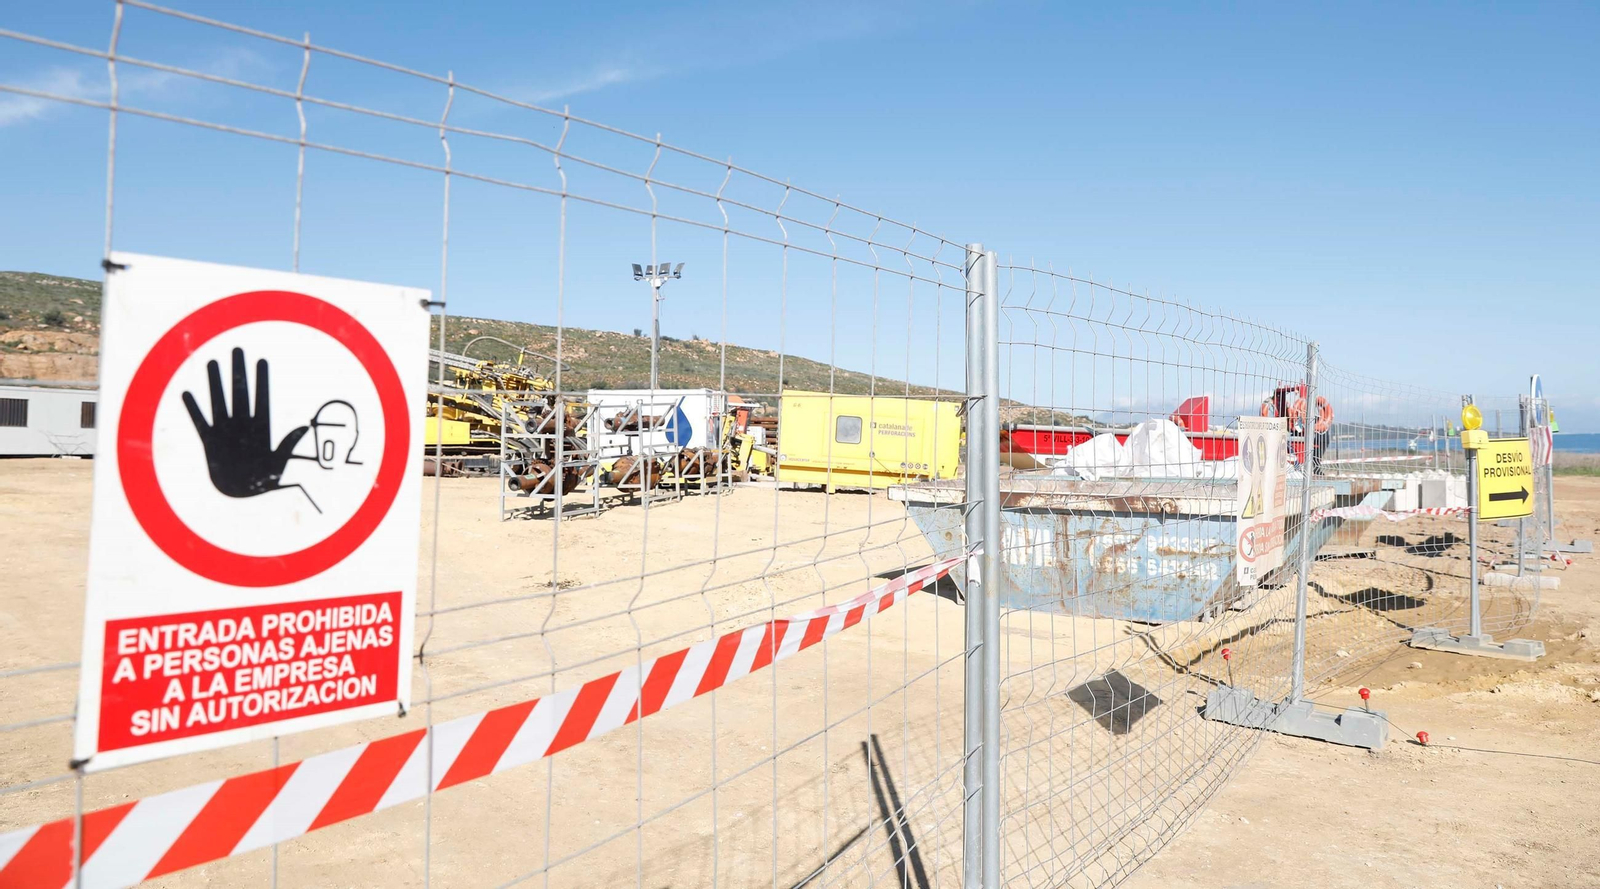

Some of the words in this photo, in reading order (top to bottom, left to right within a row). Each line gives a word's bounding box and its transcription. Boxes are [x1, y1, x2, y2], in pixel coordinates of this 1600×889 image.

[1483, 465, 1532, 478] PROVISIONAL
[111, 658, 137, 684] A
[143, 639, 295, 679] PERSONAS
[299, 625, 394, 656] AJENAS
[117, 617, 256, 655] ENTRADA
[261, 602, 394, 638] PROHIBIDA
[129, 706, 180, 736] SIN
[185, 674, 377, 727] AUTORIZACION
[162, 678, 185, 704] A
[191, 674, 226, 700] LA
[234, 654, 356, 693] EMPRESA
